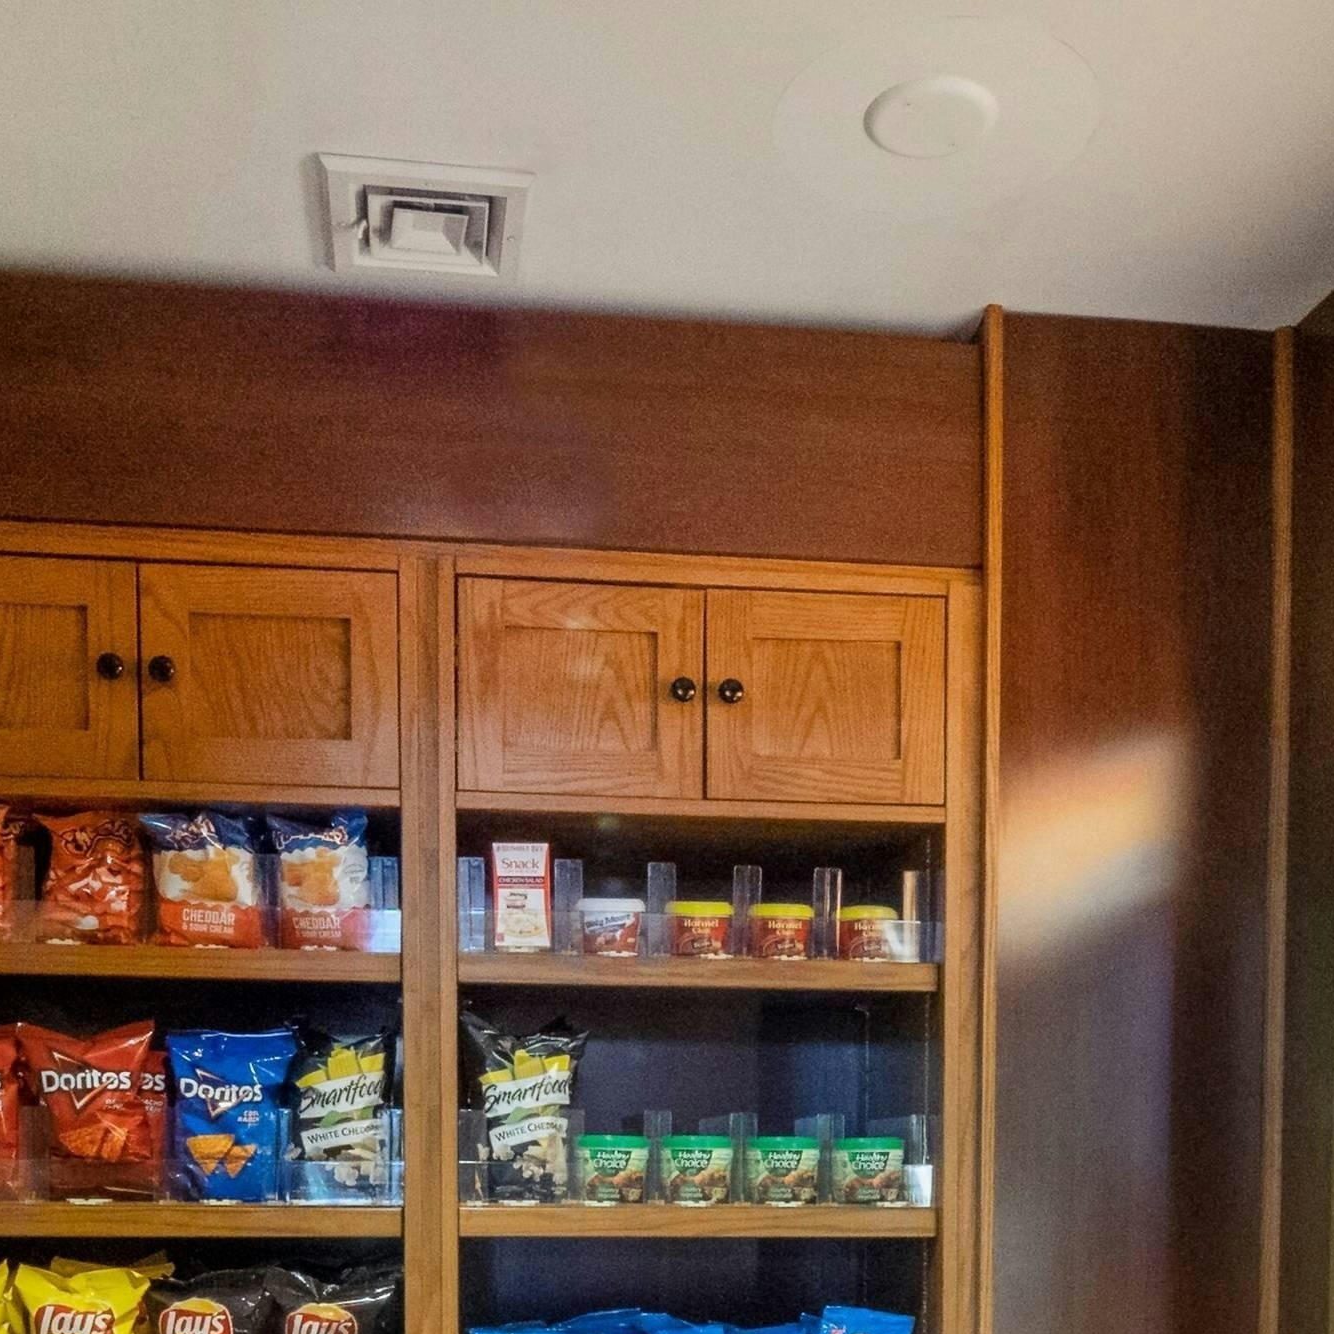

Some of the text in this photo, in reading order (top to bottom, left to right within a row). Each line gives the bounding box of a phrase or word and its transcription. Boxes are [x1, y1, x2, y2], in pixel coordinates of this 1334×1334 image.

[501, 858, 540, 870] Snack
[182, 908, 236, 925] CHEDDAR
[292, 916, 341, 930] CHEDDAR
[41, 1069, 131, 1093] Doritos
[179, 1078, 264, 1103] Doritos
[307, 1129, 340, 1145] WHITE
[495, 1126, 527, 1142] WHITE
[594, 1158, 627, 1169] Choice
[675, 1158, 708, 1169] Choice
[766, 1159, 798, 1169] Choice
[852, 1161, 885, 1171] Choice
